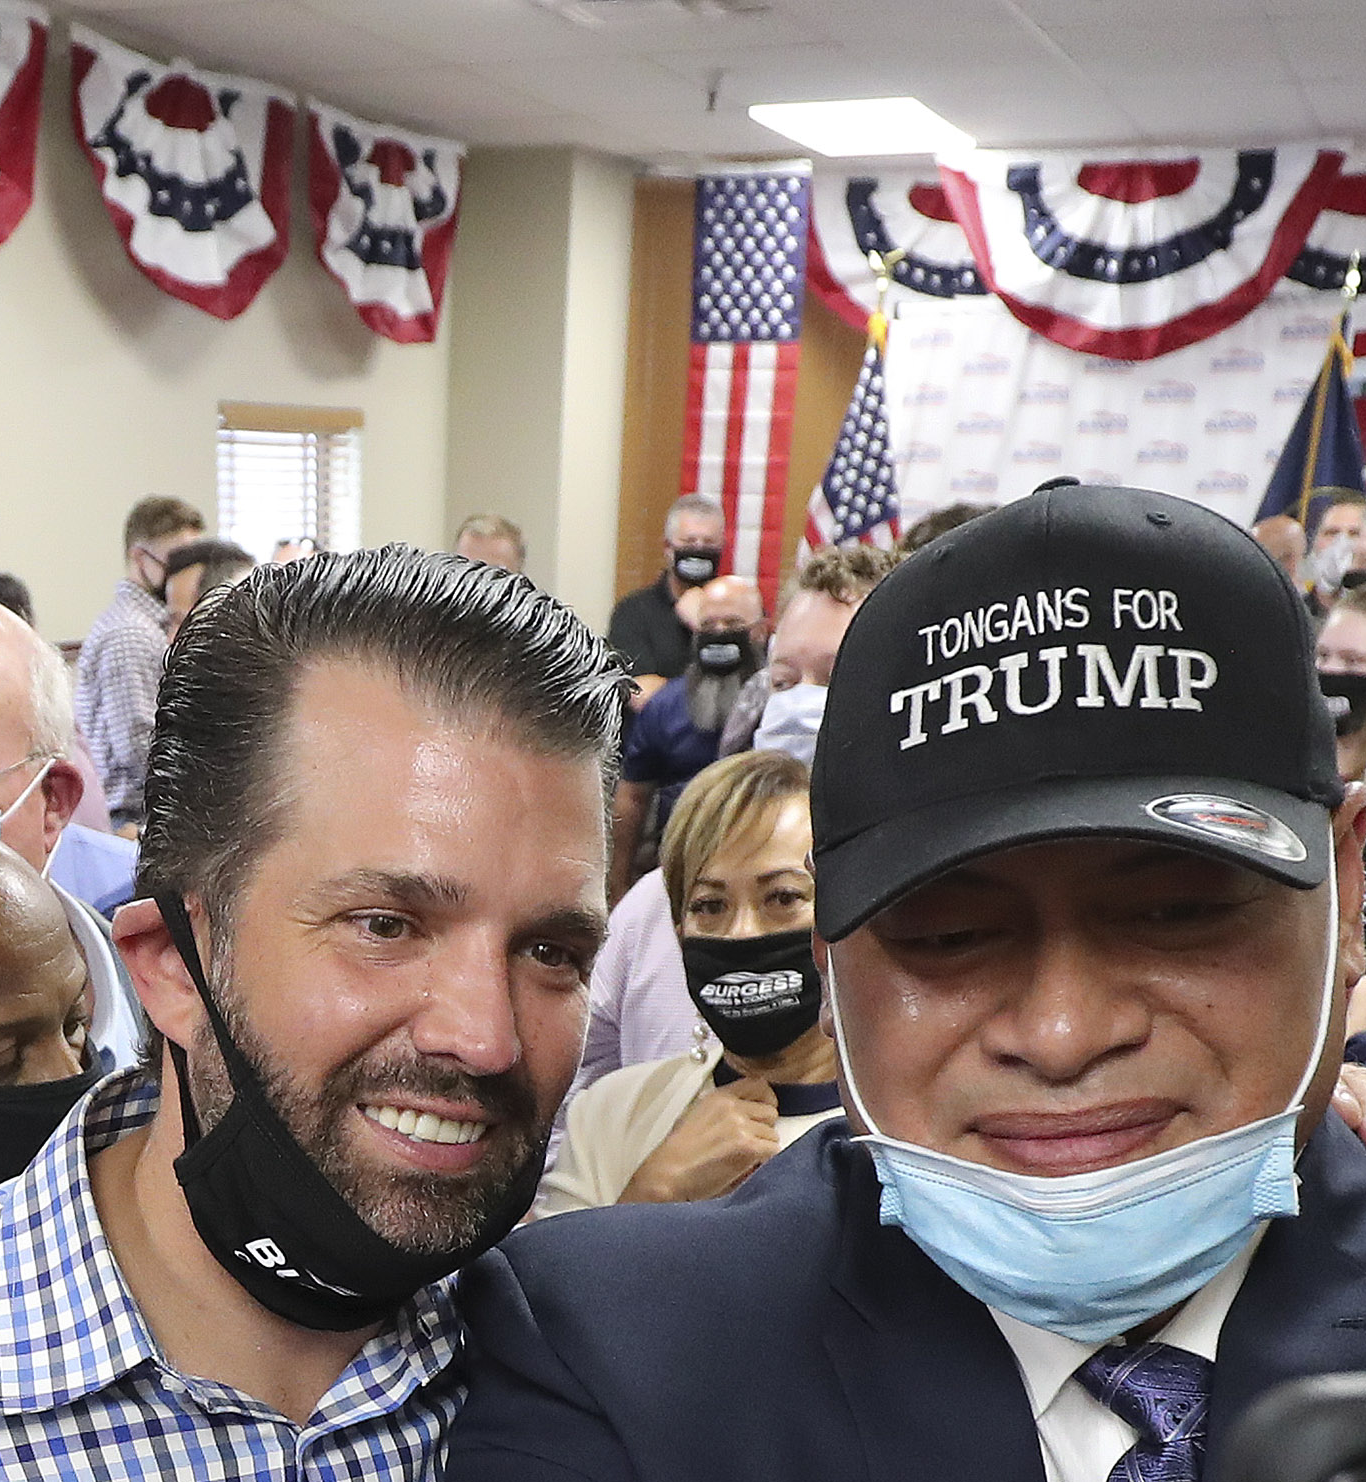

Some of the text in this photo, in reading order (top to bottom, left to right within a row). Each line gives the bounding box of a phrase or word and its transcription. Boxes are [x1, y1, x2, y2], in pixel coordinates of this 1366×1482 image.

[918, 587, 1183, 665] TONGANS FOR
[890, 643, 1219, 750] TRUMP
[699, 973, 803, 998] BURGESS
